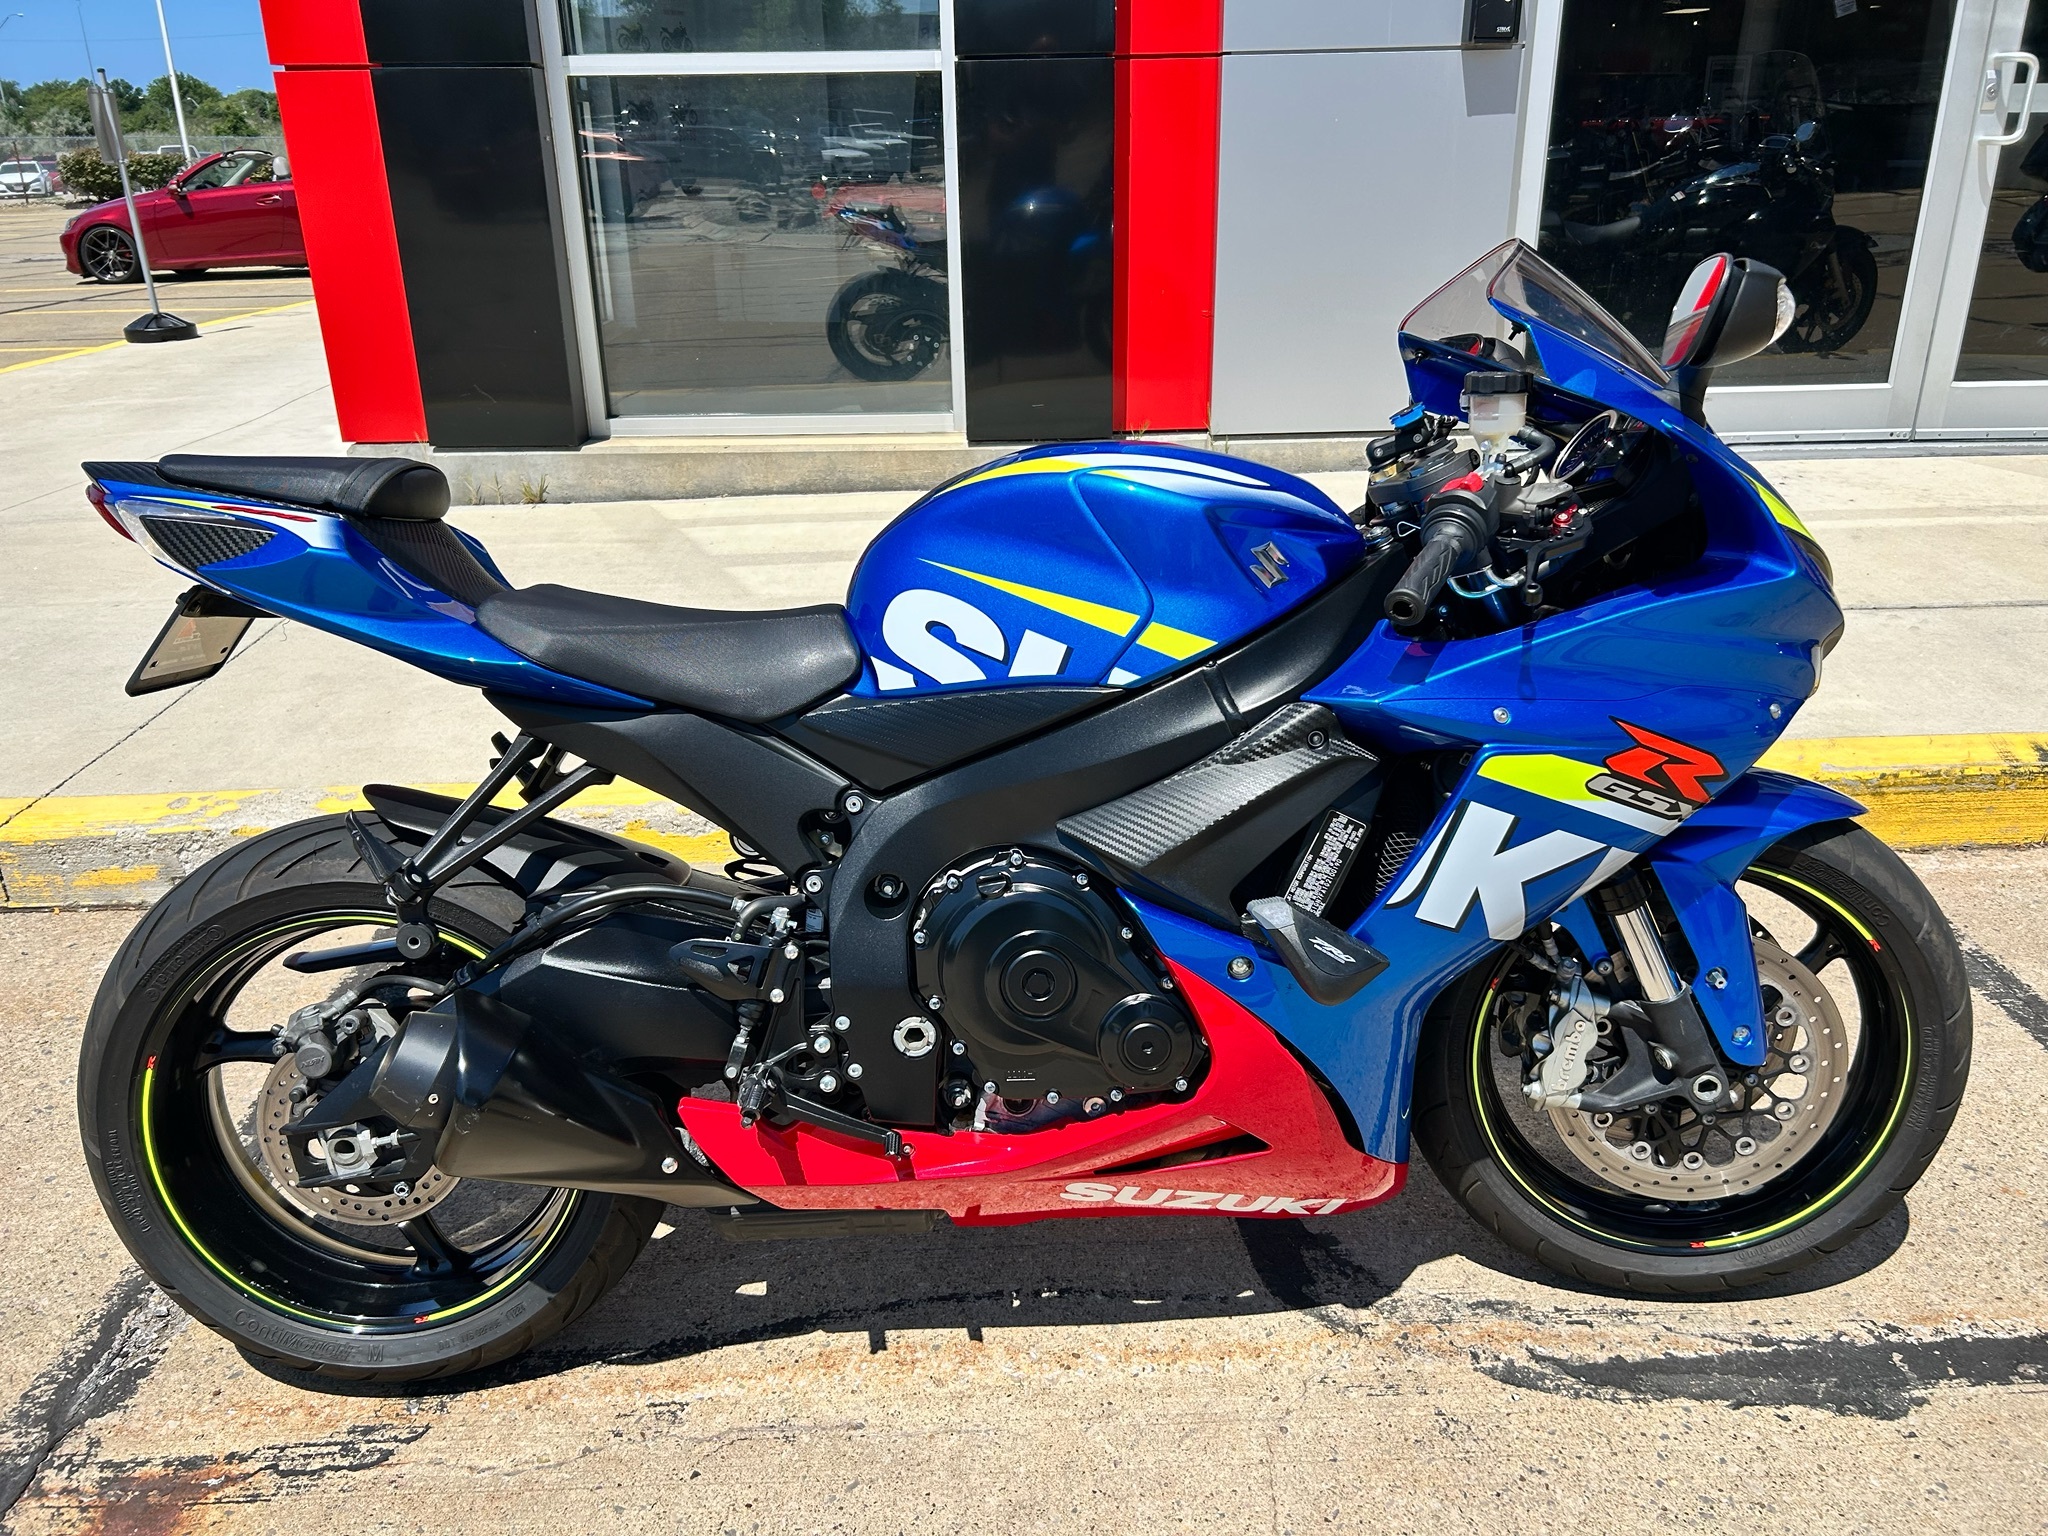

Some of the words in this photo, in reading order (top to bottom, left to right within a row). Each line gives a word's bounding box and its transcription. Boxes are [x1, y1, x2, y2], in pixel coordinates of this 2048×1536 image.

[1604, 715, 1730, 804] R
[1551, 1020, 1586, 1091] brembo
[1060, 1182, 1348, 1214] SUZUKI
